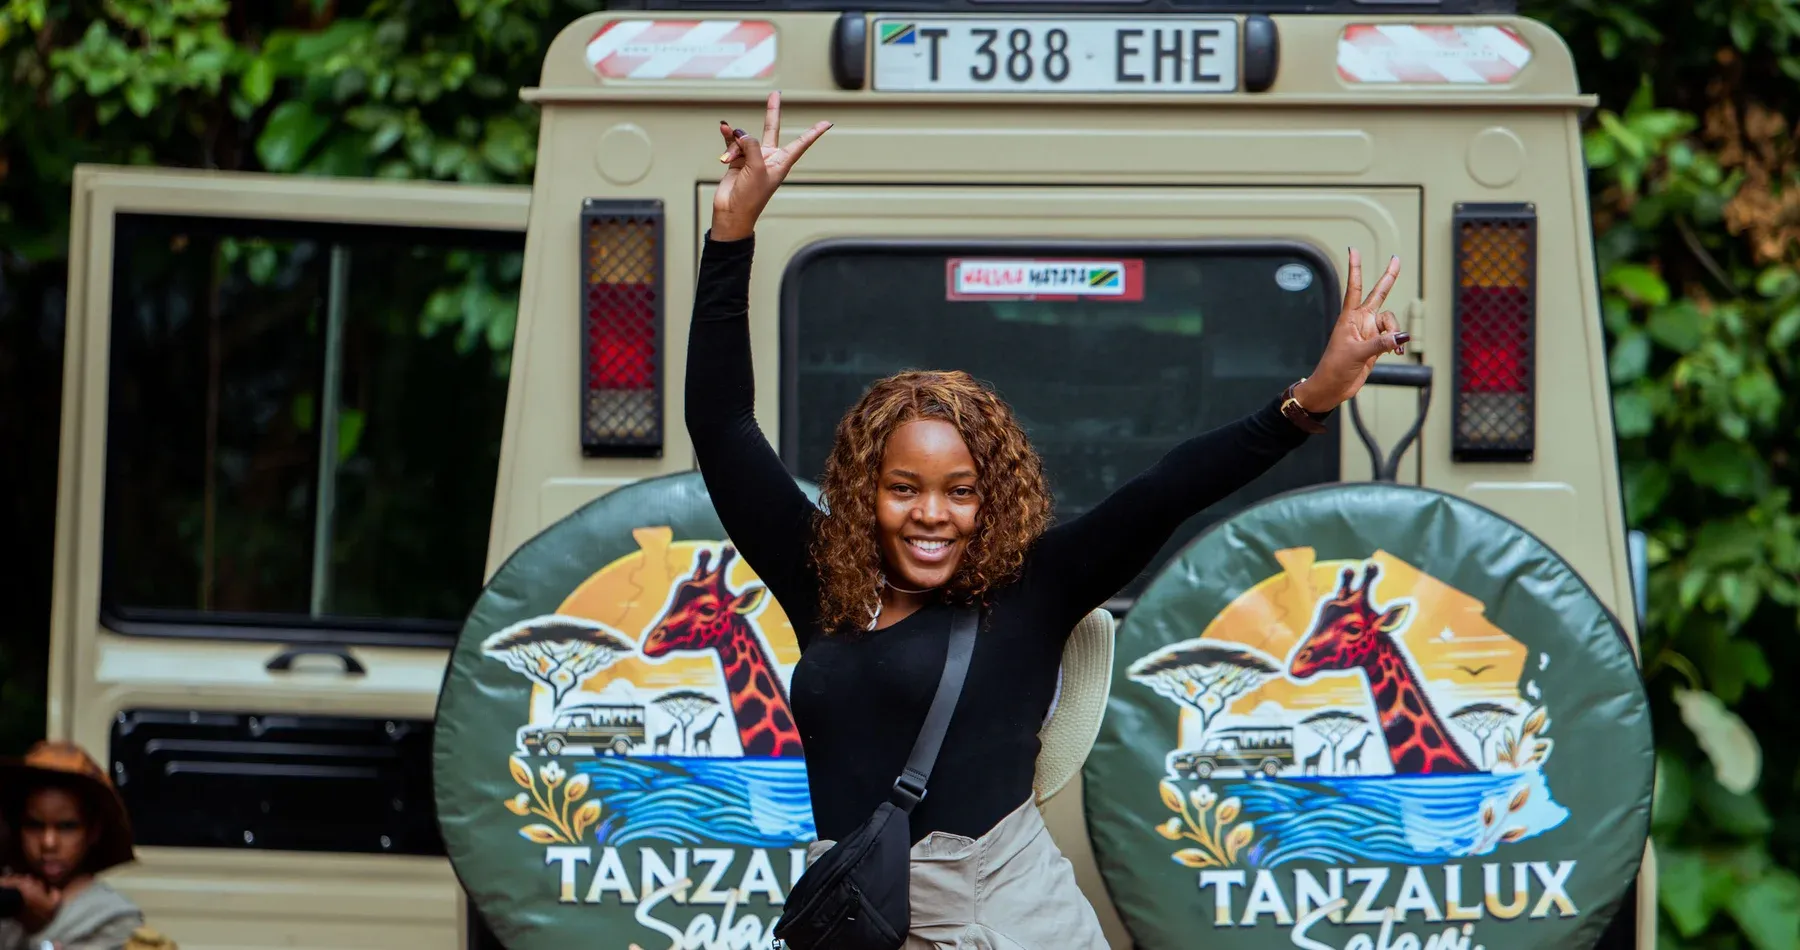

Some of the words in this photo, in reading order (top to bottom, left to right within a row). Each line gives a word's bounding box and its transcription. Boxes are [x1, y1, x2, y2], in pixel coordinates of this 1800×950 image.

[919, 28, 949, 82] T
[969, 28, 1070, 83] 388
[1114, 28, 1221, 83] EHE
[1199, 859, 1580, 927] TANZALUX
